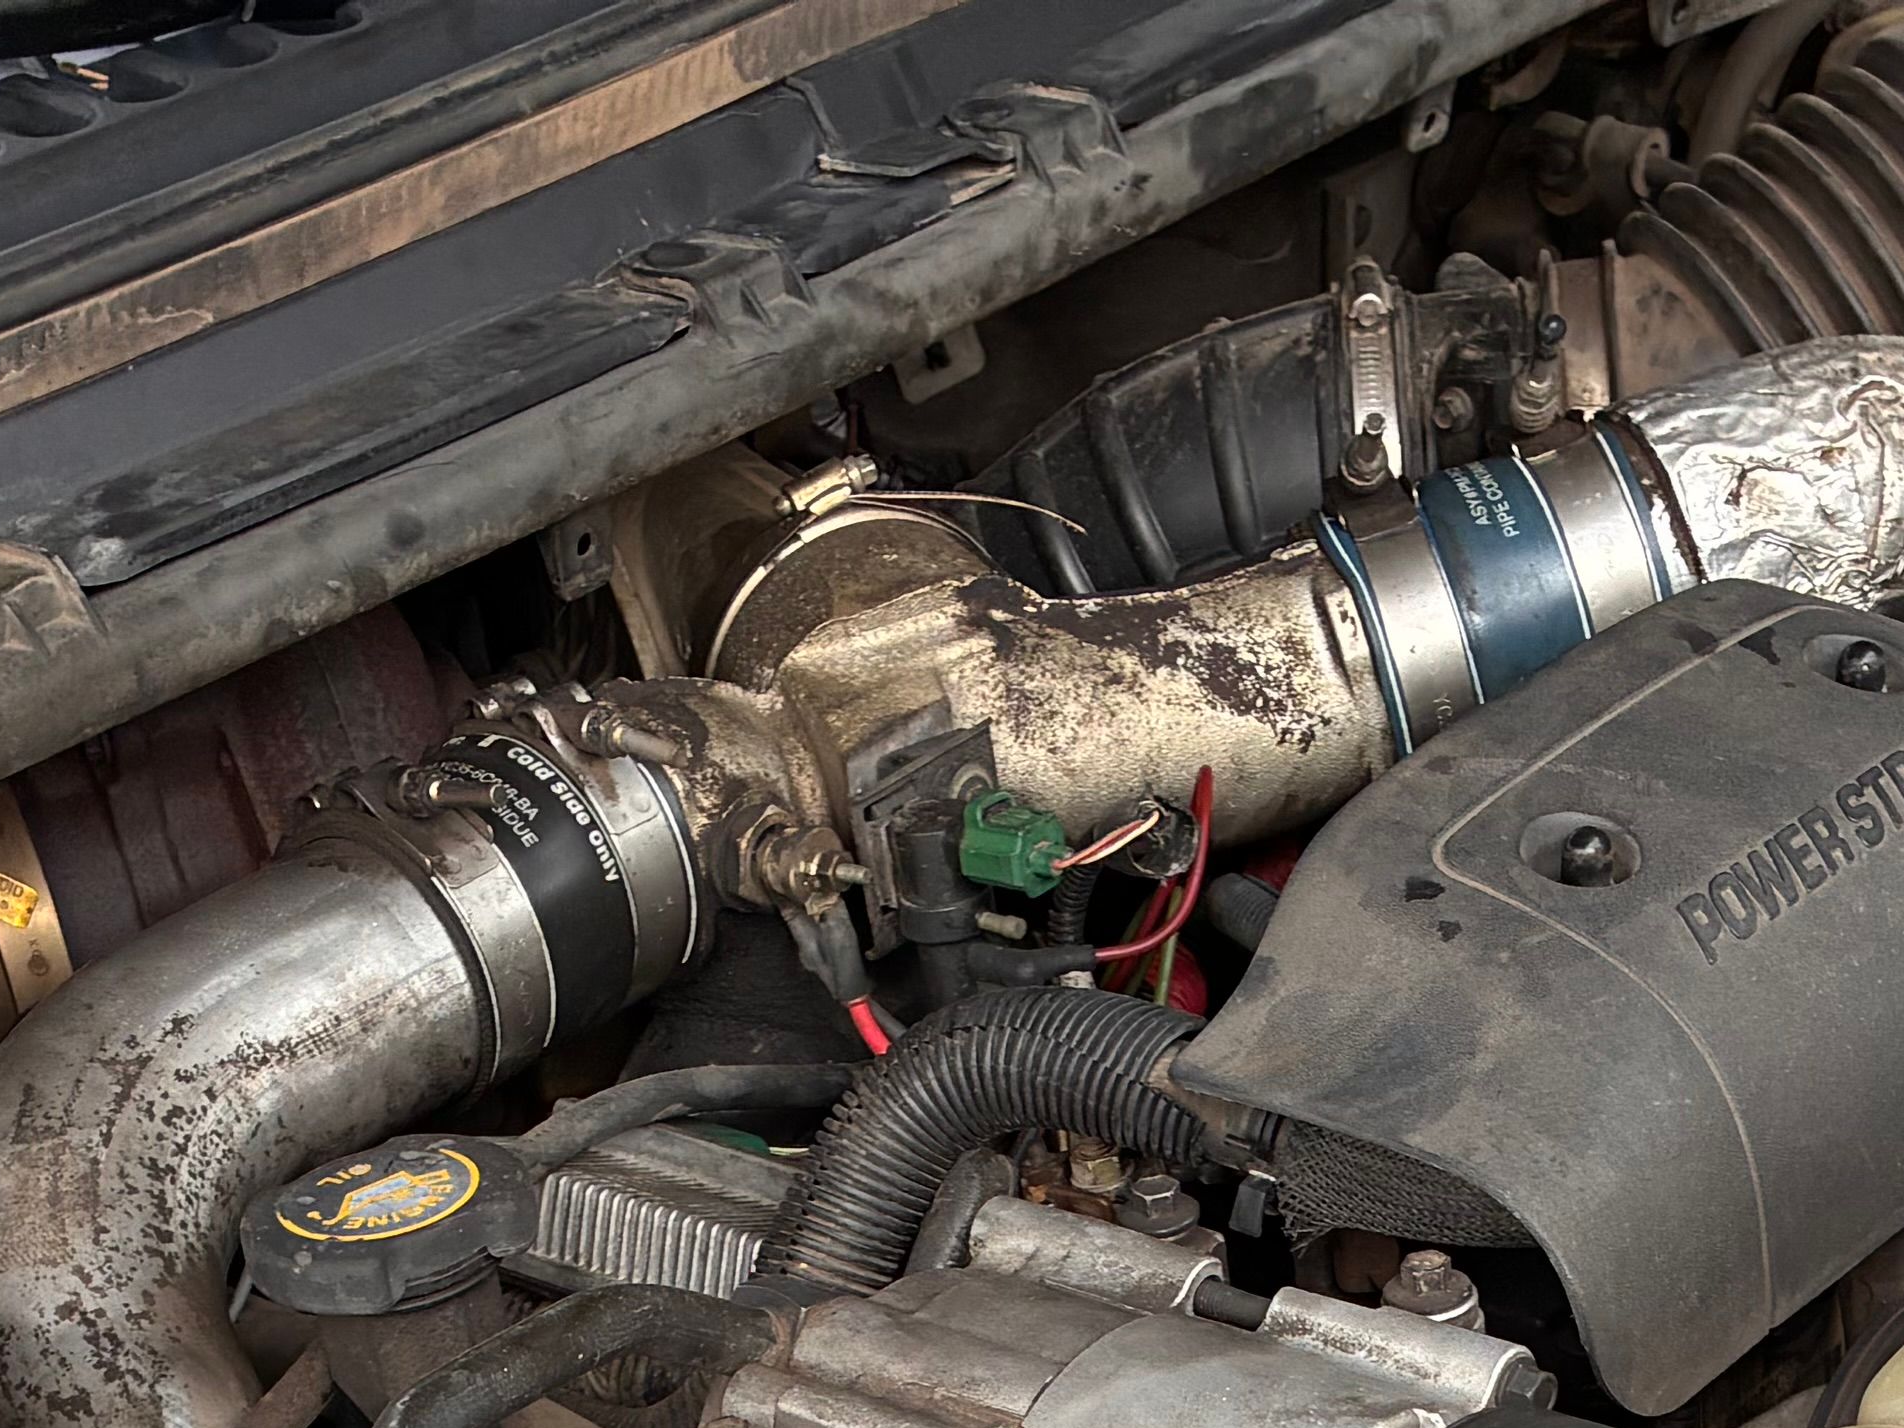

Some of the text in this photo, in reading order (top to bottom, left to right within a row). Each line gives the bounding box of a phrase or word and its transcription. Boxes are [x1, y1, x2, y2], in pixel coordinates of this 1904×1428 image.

[1492, 501, 1520, 538] PIPE
[507, 747, 556, 782] Cold
[550, 781, 591, 826] Side
[588, 829, 620, 882] Only
[1676, 806, 1855, 966] POWER
[316, 1163, 372, 1187] OIL
[342, 1183, 455, 1230] ENGINE
